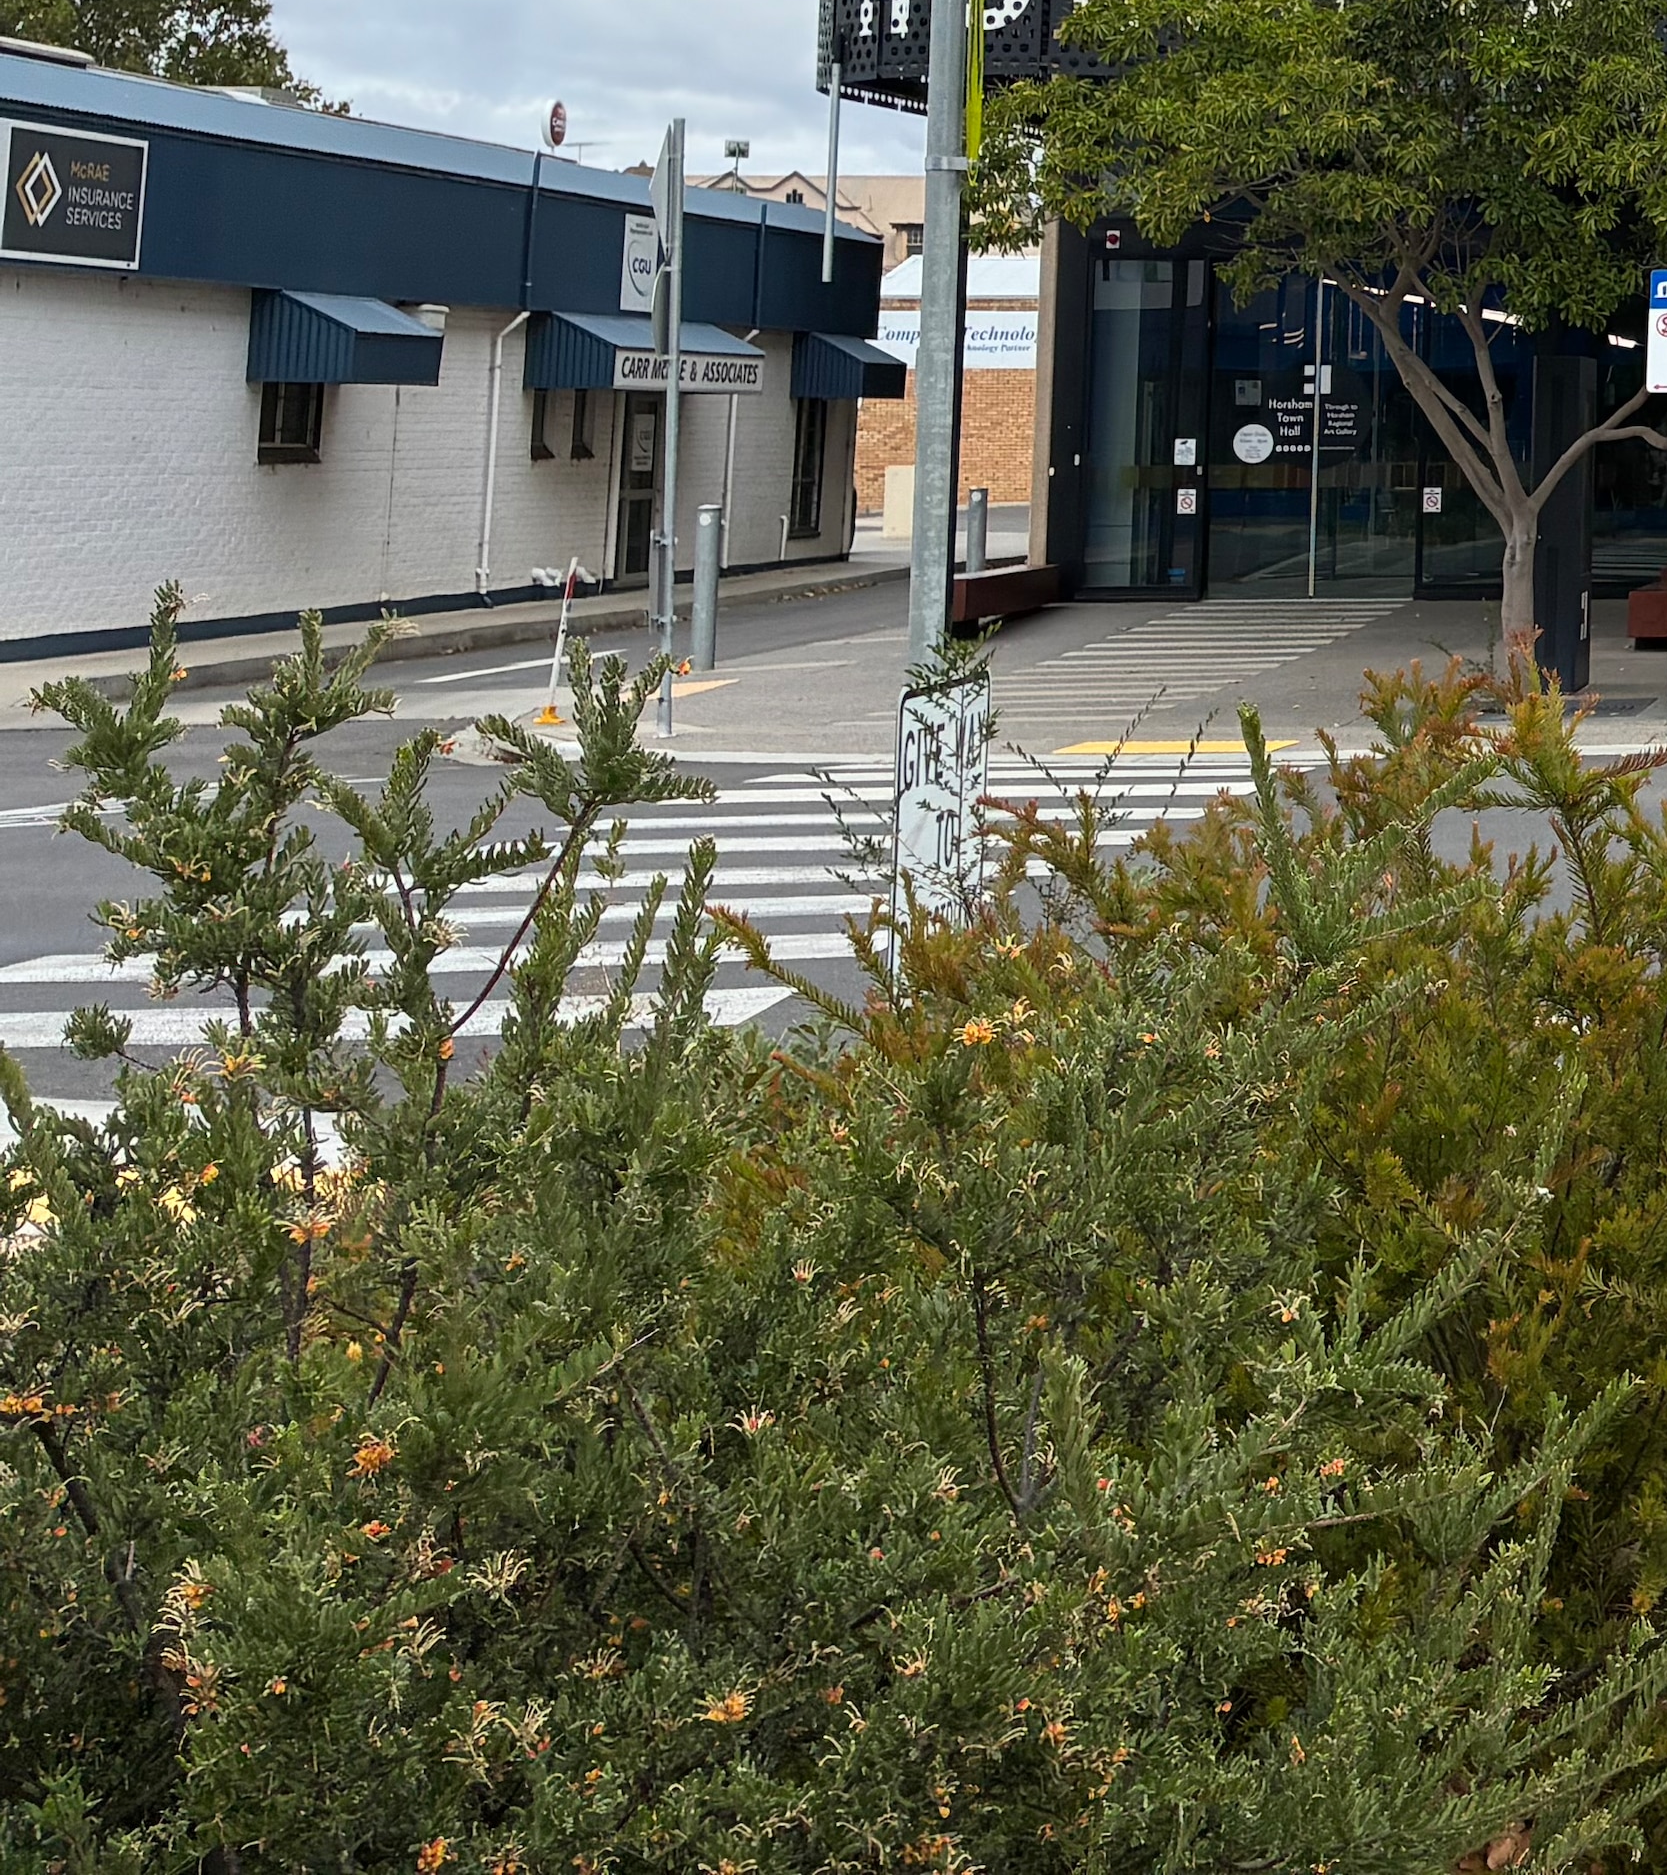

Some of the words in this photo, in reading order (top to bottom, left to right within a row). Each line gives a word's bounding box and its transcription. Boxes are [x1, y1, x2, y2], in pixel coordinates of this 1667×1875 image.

[70, 160, 111, 182] McRAE
[68, 185, 134, 210] INSURANCE
[66, 206, 122, 230] SERVICES
[632, 257, 652, 275] CGU
[621, 355, 649, 380] CARR
[690, 360, 698, 381] &
[702, 361, 759, 384] ASSOCIATES
[1268, 398, 1313, 409] Horsham
[1276, 412, 1304, 423] Town
[1279, 425, 1301, 436] Hall
[904, 722, 945, 791] GIVE
